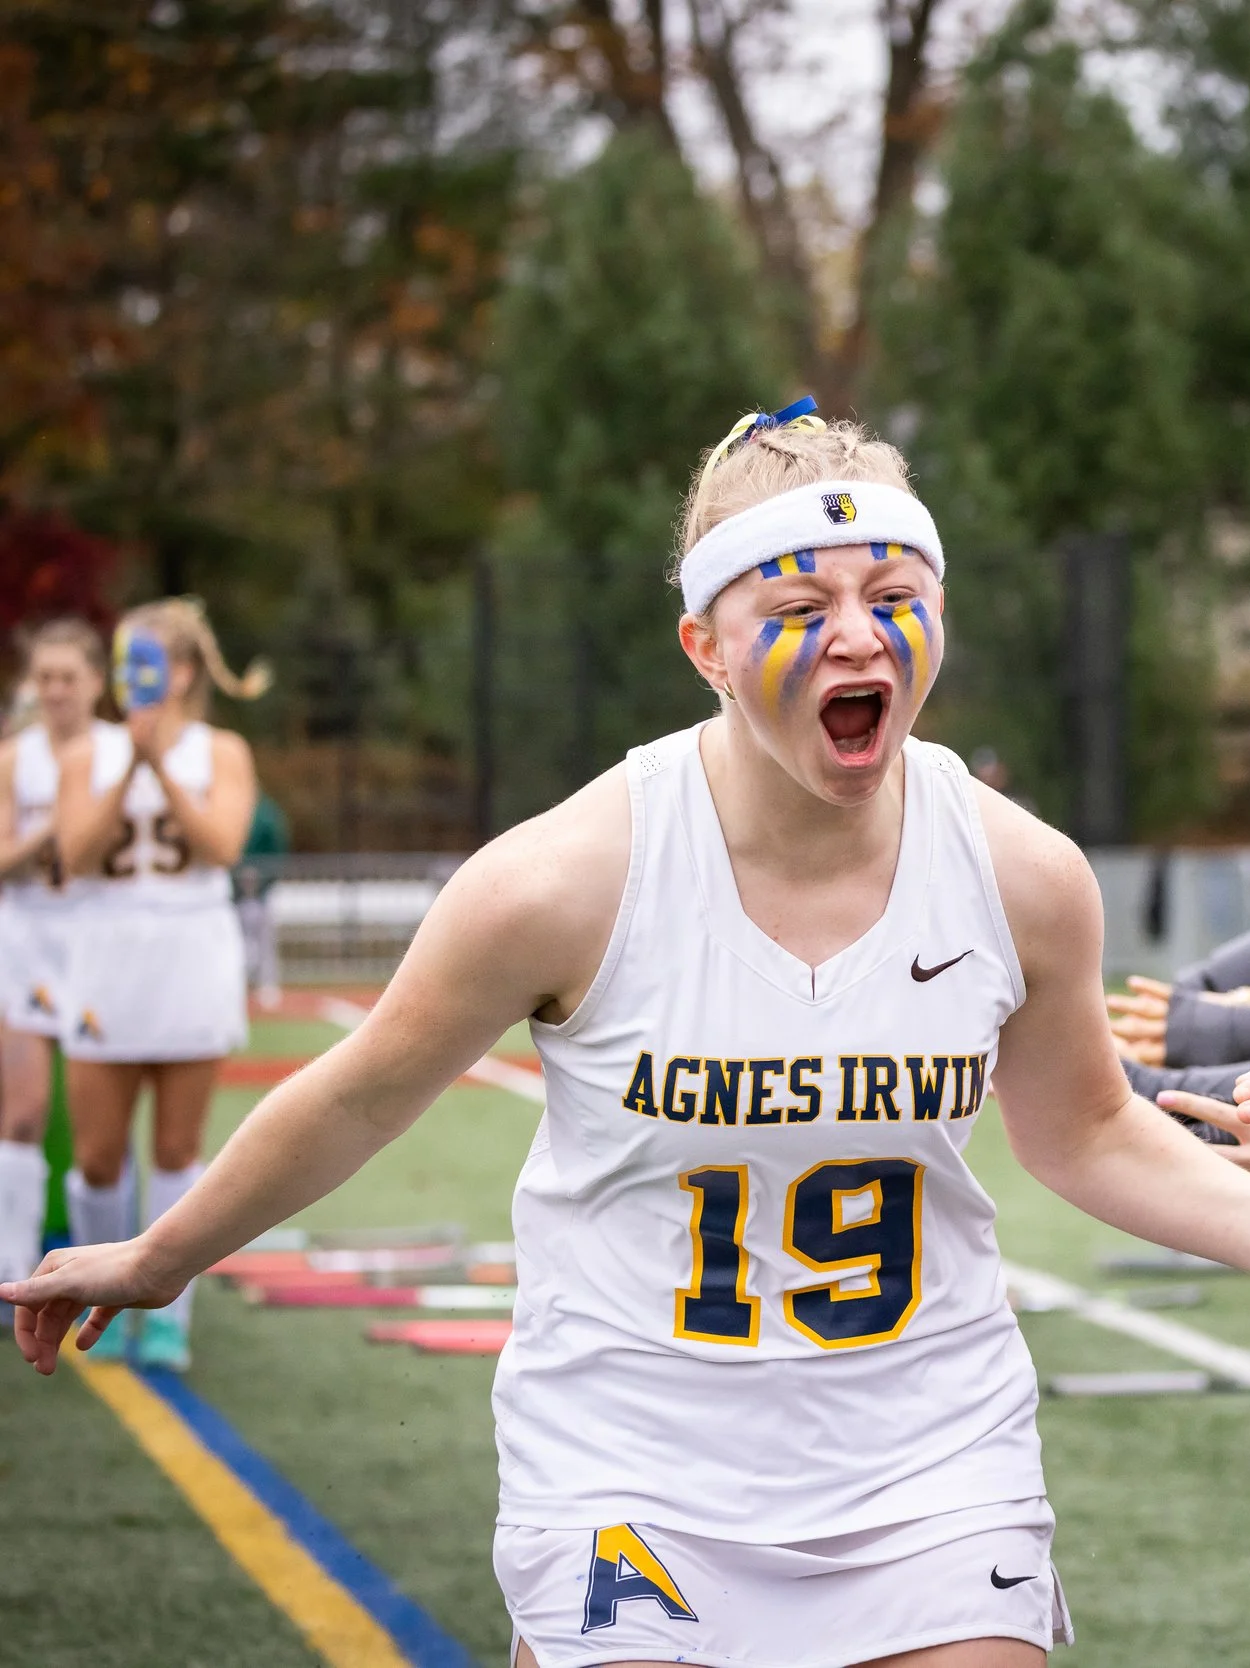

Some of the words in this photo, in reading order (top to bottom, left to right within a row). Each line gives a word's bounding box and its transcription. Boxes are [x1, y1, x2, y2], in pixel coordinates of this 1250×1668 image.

[622, 1051, 824, 1126] AGNES
[835, 1055, 988, 1122] IRWIN
[673, 1157, 926, 1350] 19
[581, 1522, 699, 1635] A
